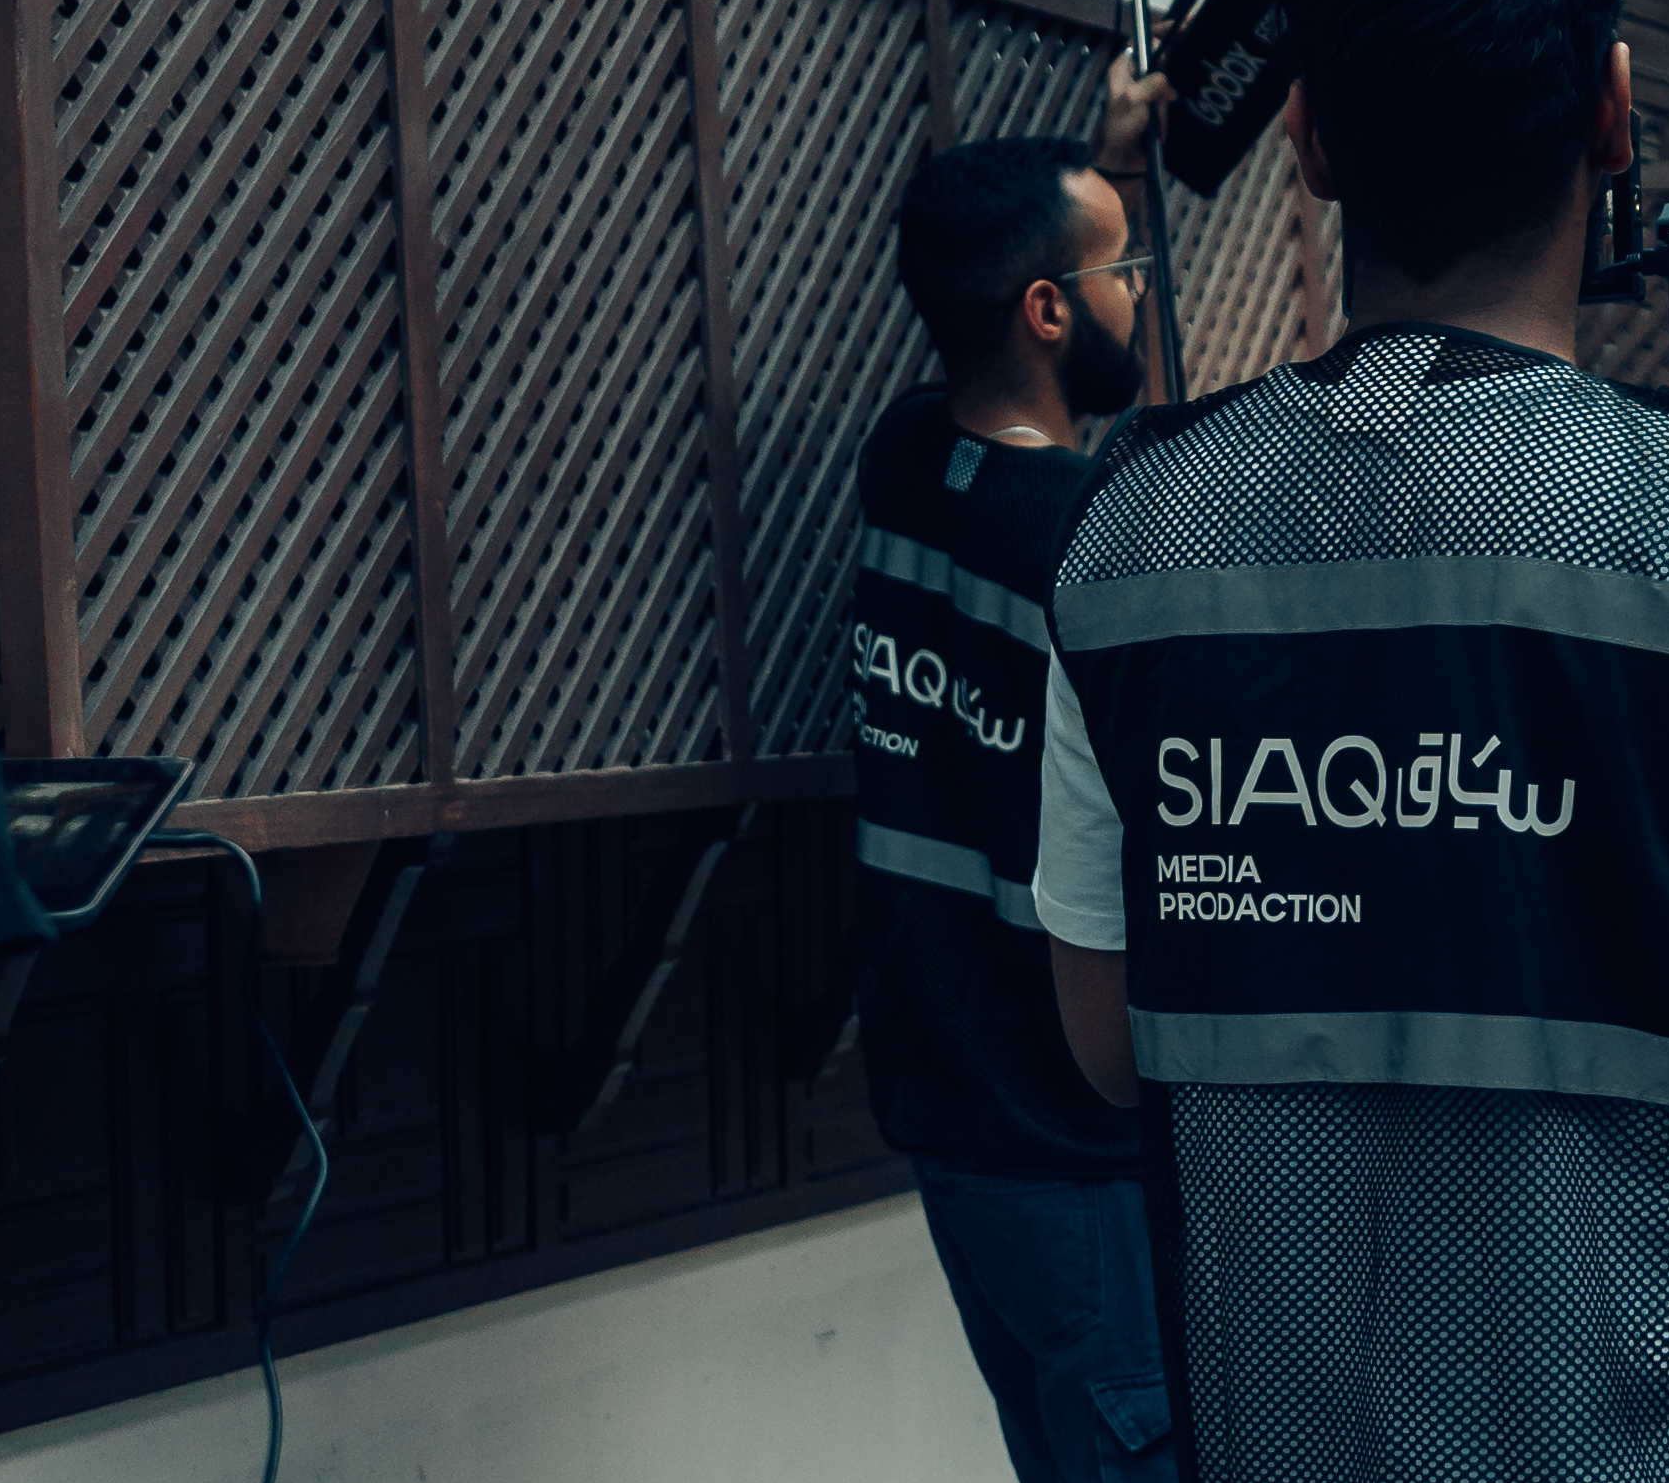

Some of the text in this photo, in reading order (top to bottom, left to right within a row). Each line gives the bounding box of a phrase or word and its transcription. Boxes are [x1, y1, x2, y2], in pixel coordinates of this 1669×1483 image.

[1157, 735, 1387, 828] SIAQ
[1157, 855, 1262, 883] MEDIA
[1159, 892, 1361, 922] PRODACTION
